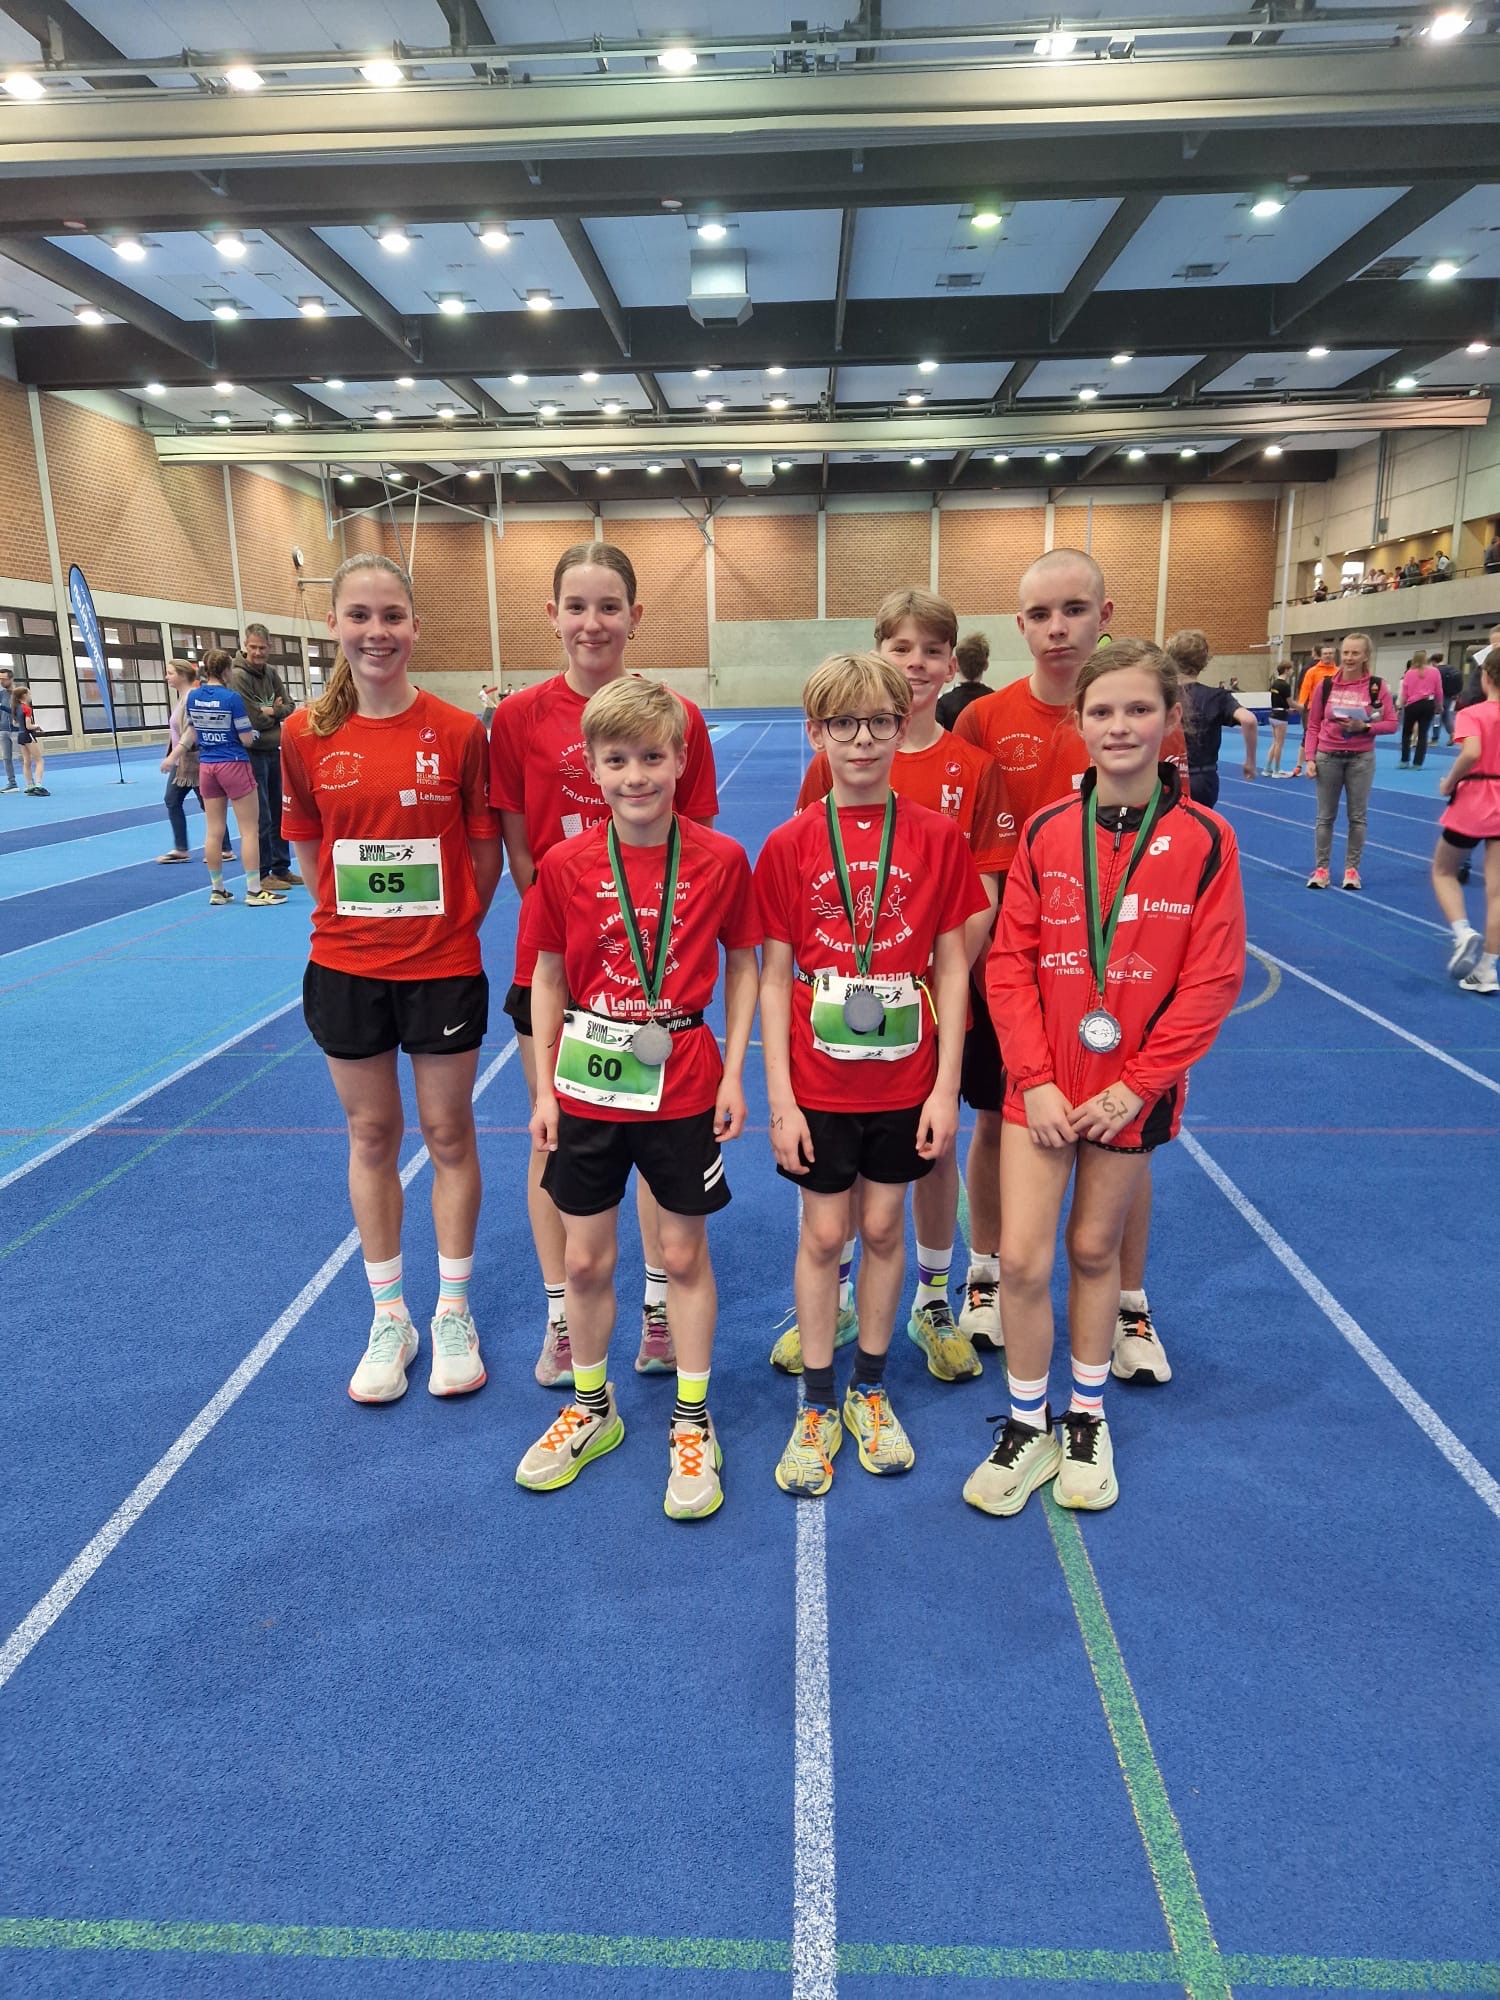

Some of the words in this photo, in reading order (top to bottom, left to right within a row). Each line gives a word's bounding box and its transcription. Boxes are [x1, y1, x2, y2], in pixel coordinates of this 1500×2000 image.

[202, 732, 228, 742] BODE
[420, 792, 452, 802] Lehmann
[359, 845, 385, 853] SWIM
[369, 872, 405, 893] 65
[812, 861, 879, 890] LEHTER
[1143, 898, 1195, 914] Lehma
[600, 907, 658, 930] LEHTER
[601, 959, 680, 987] TRIATHL.DE
[1107, 969, 1153, 980] NELKE
[587, 1020, 609, 1033] SWIM
[666, 1017, 692, 1031] ailfish
[587, 1054, 622, 1081] 60
